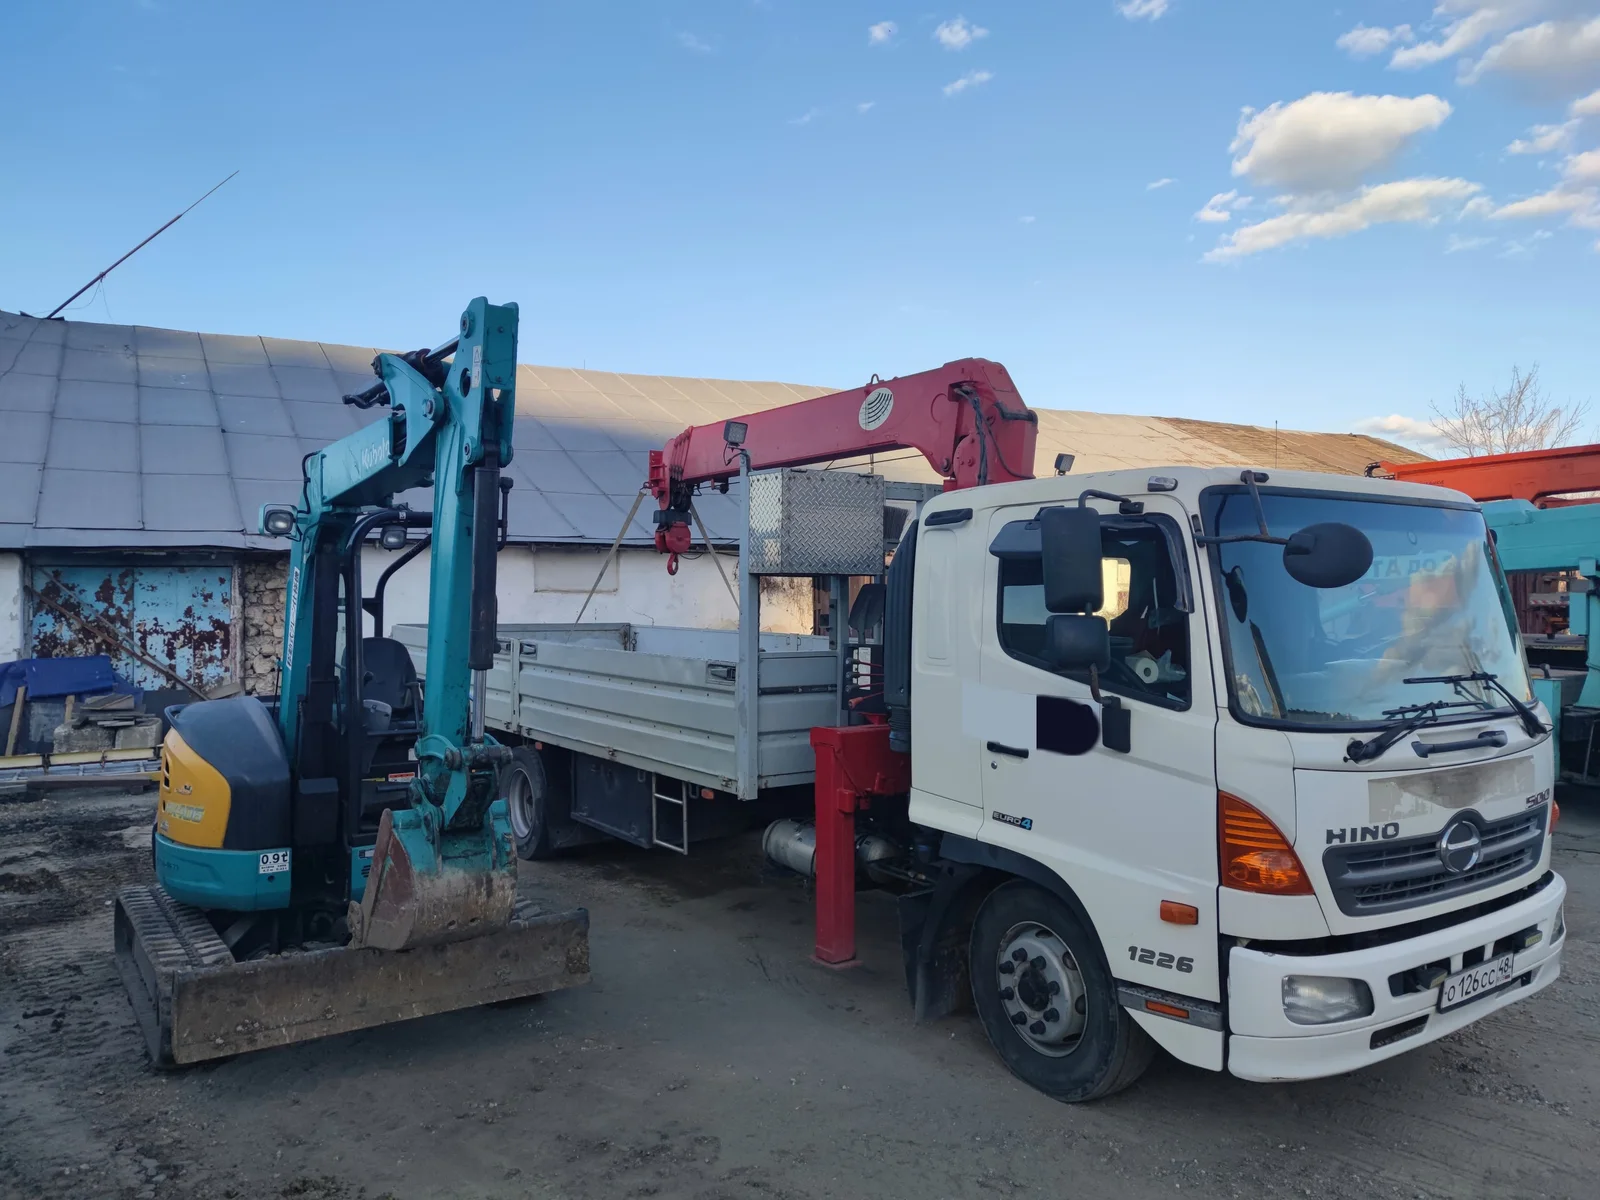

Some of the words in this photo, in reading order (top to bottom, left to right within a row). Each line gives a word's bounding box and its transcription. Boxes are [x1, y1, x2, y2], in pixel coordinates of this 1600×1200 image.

[1526, 788, 1550, 808] 500
[1325, 822, 1400, 845] HINO
[1128, 945, 1194, 973] 1226
